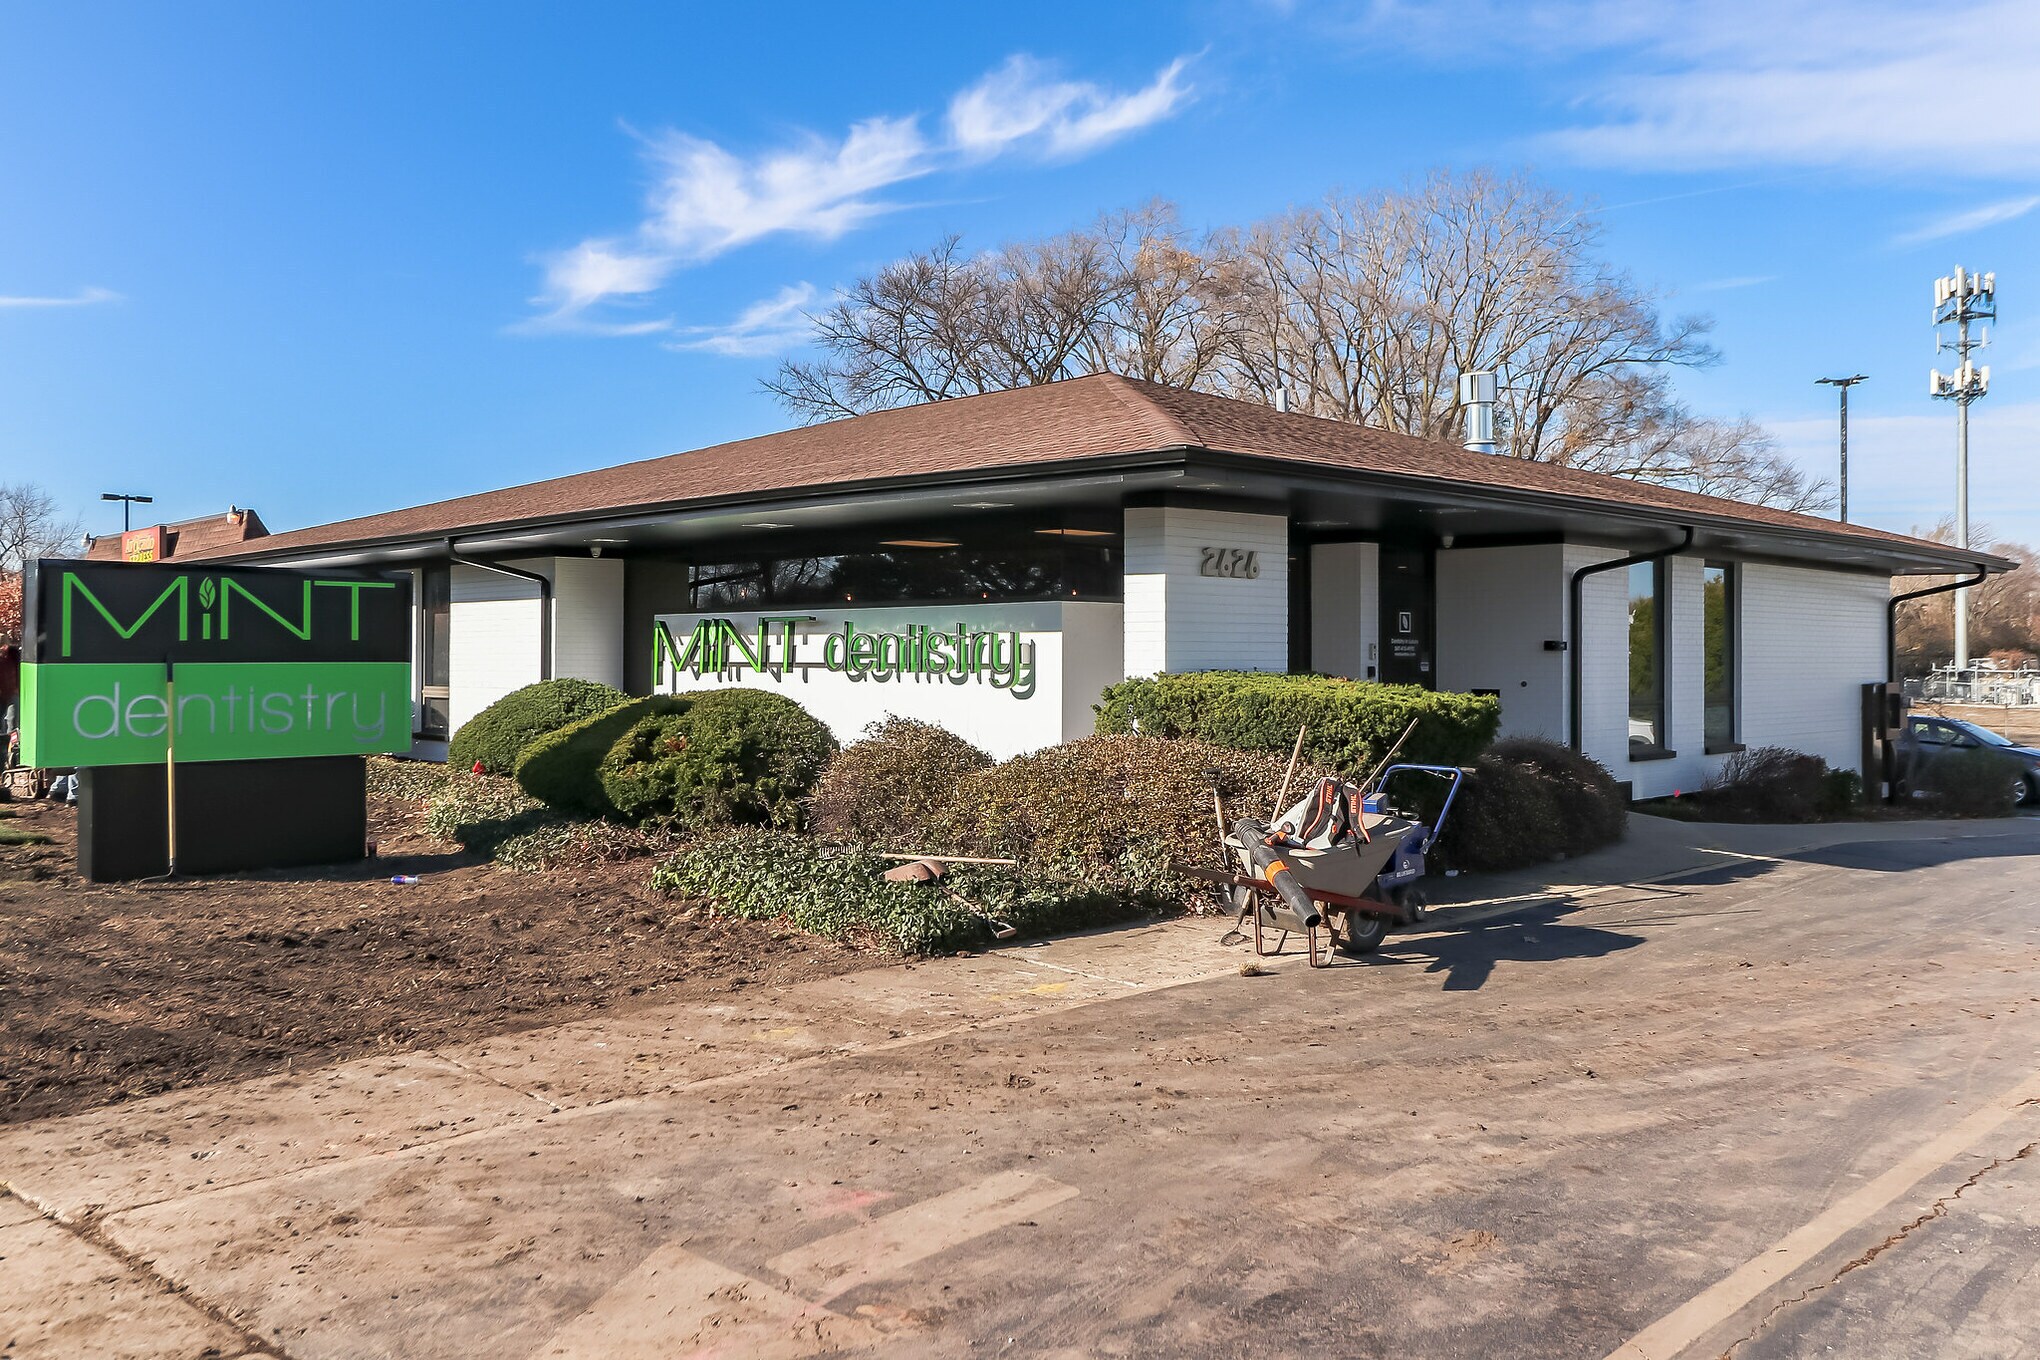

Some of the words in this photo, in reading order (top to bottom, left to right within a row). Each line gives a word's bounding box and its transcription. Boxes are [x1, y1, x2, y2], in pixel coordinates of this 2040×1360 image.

[1201, 547, 1260, 579] 2626
[823, 620, 1021, 689] dentistry
[73, 682, 386, 744] dentistry
[1325, 783, 1333, 804] STIHL
